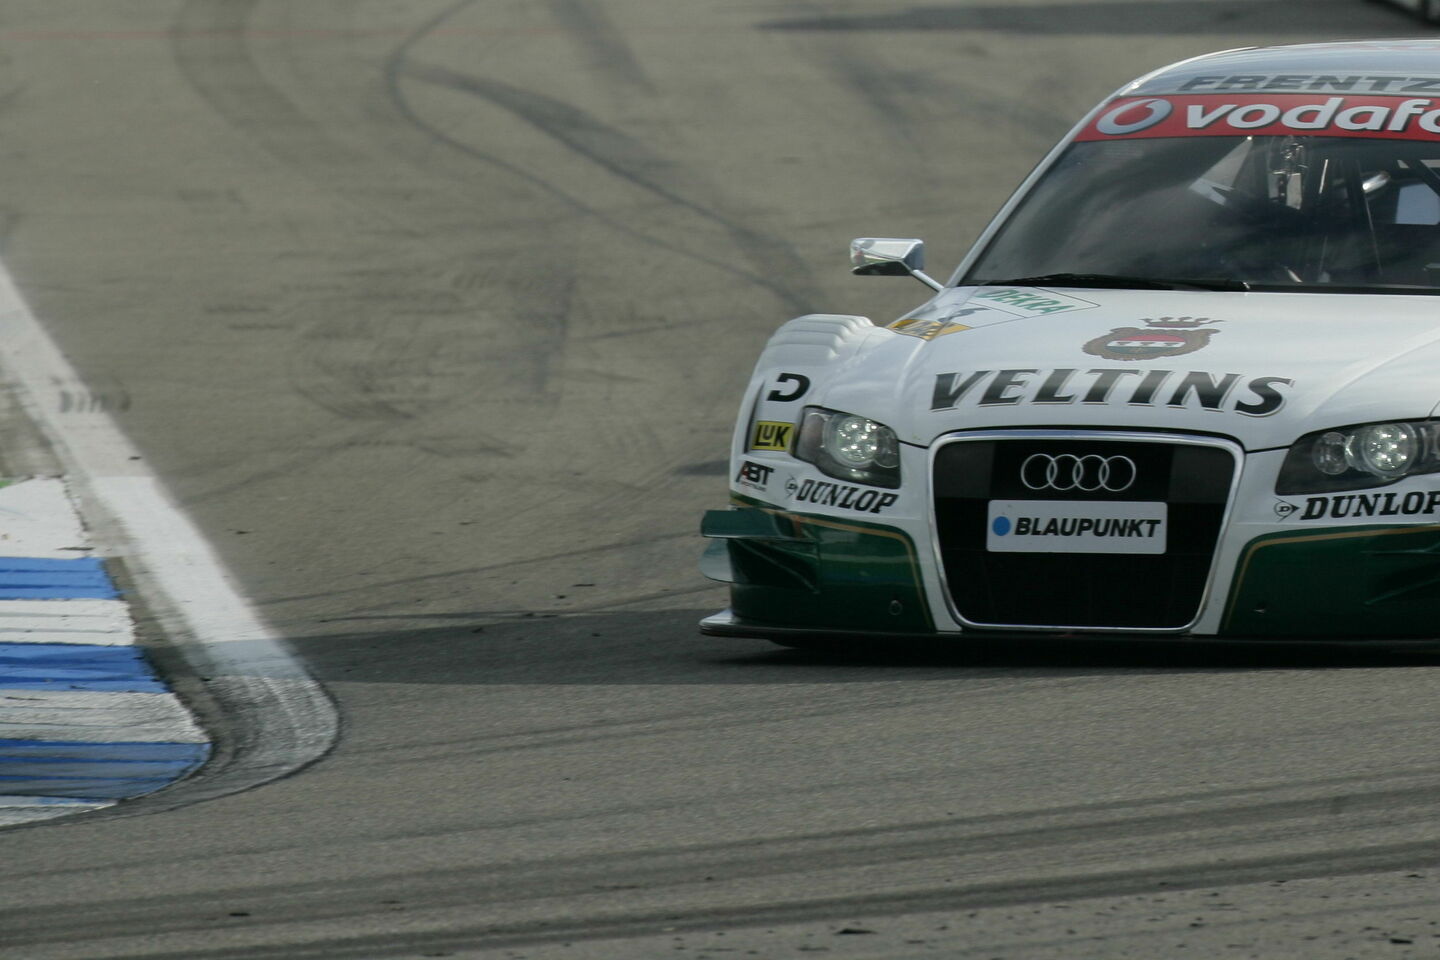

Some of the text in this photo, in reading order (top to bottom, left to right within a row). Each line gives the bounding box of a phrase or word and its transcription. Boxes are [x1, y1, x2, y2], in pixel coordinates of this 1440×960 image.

[975, 289, 1076, 316] DEKRA
[930, 367, 1296, 419] VELTINS
[735, 460, 775, 485] ABT
[796, 478, 899, 514] DUNLOP
[1014, 516, 1162, 538] BLAUPUNKT
